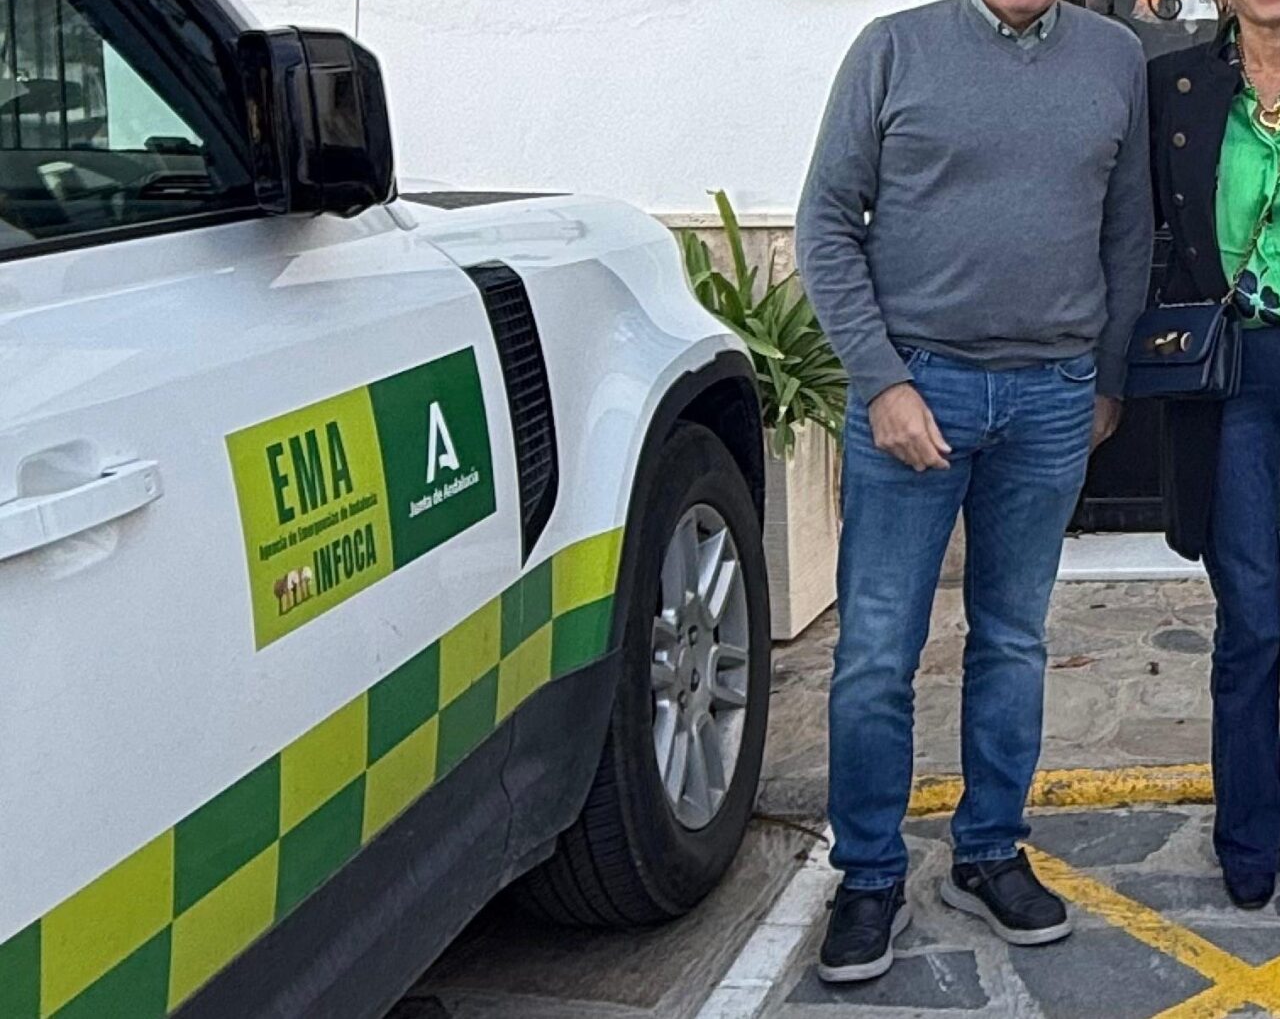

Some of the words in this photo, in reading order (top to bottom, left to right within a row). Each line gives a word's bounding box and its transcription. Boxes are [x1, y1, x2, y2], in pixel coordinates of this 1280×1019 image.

[266, 420, 354, 526] EMA
[409, 495, 433, 518] Junta
[433, 488, 443, 505] de
[313, 523, 378, 596] INFOCA
